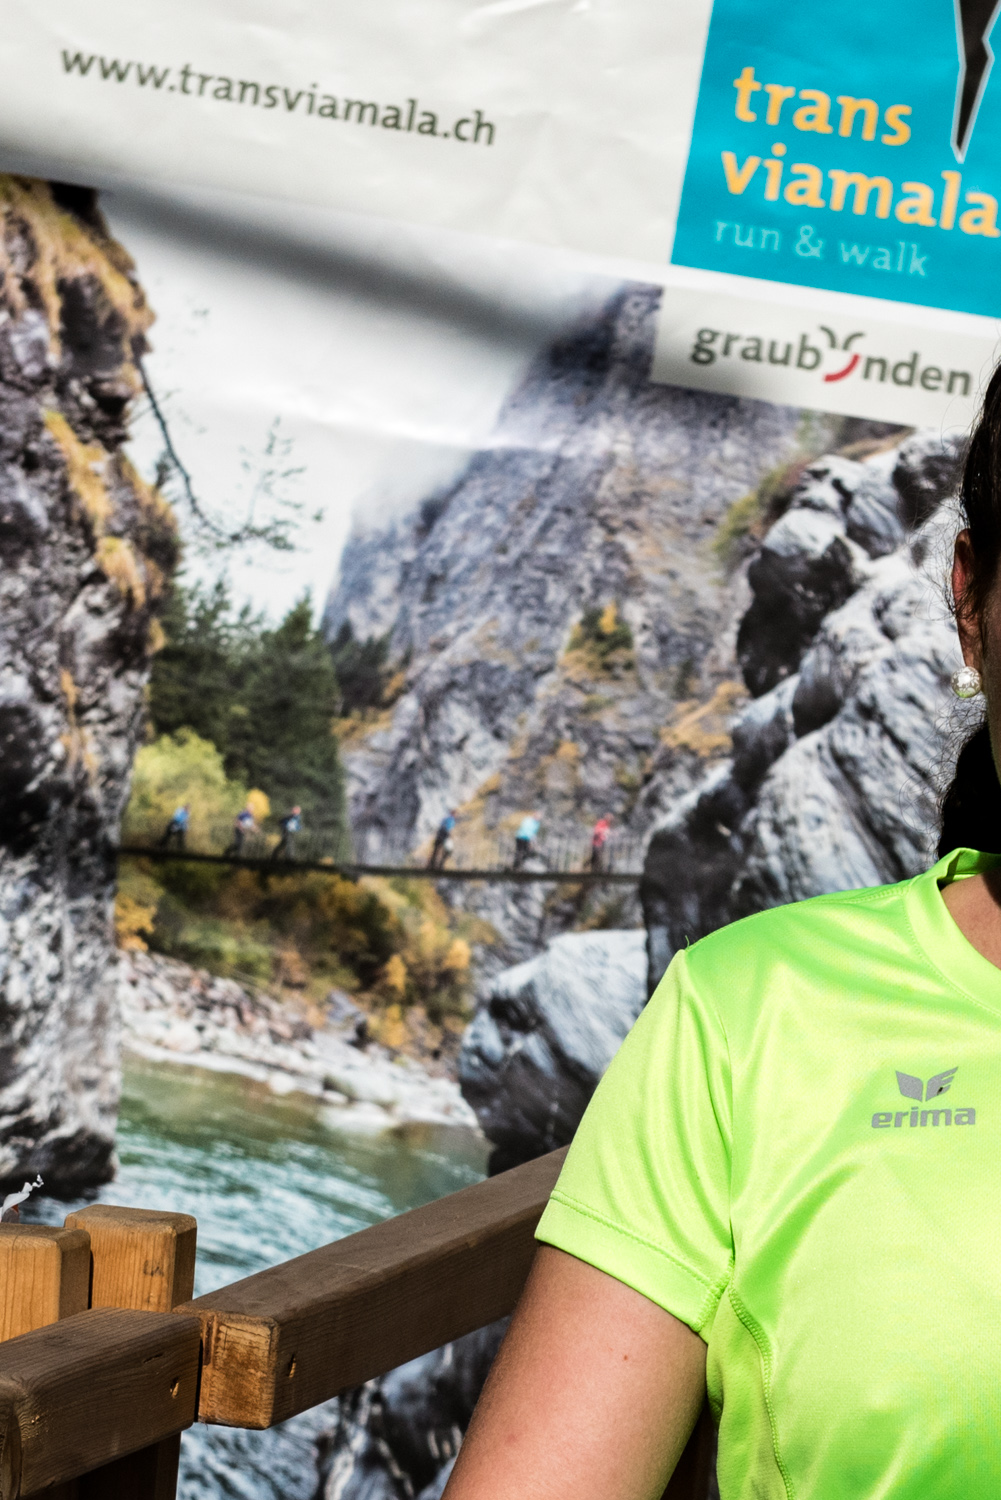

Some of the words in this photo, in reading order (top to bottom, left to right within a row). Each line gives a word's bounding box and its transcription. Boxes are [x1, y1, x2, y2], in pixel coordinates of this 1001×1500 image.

[61, 48, 496, 146] www.transviamala.ch
[733, 66, 912, 146] trans
[721, 143, 1001, 238] viamala
[715, 220, 780, 251] run
[795, 225, 824, 259] &
[840, 241, 928, 276] walk
[871, 1103, 976, 1129] erima
